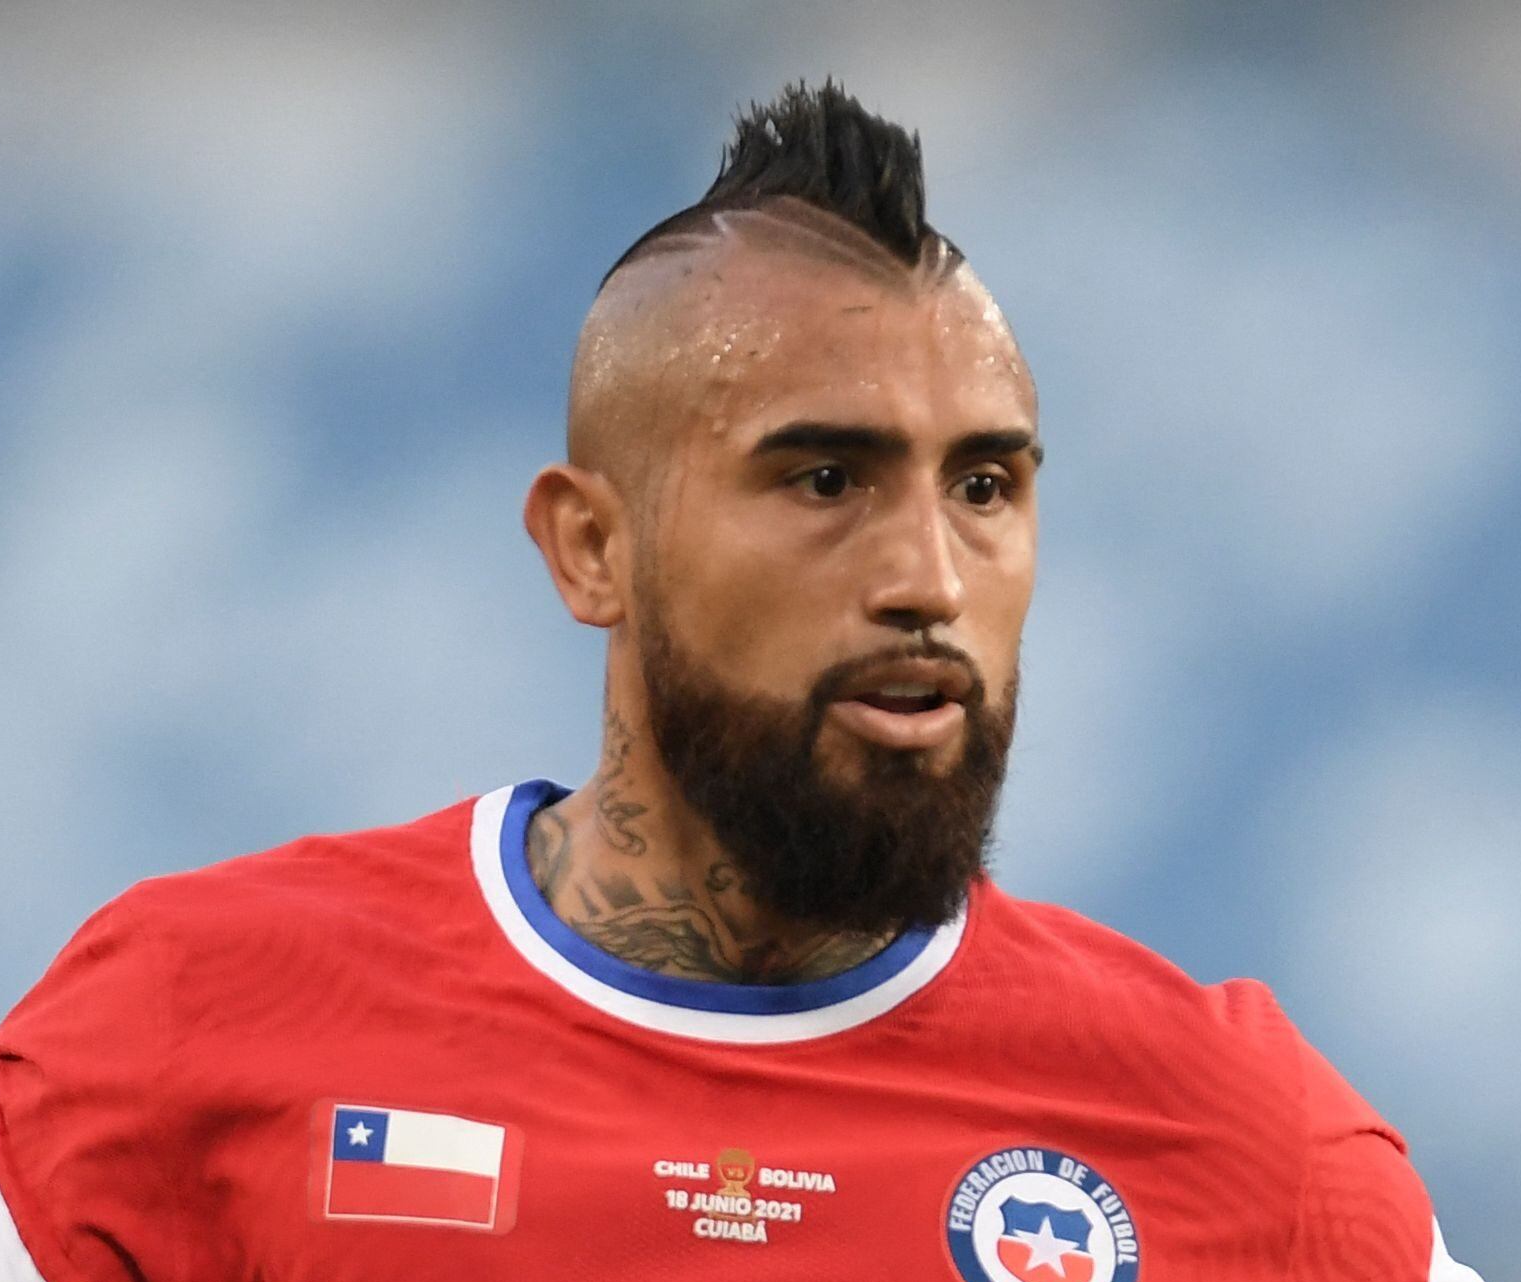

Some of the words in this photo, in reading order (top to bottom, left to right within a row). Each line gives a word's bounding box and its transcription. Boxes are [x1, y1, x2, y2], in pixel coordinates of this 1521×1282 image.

[654, 1160, 711, 1180] CHILE
[758, 1167, 836, 1193] BOLIVIA
[665, 1189, 689, 1209] 18
[689, 1193, 752, 1216] JUNIO
[754, 1200, 802, 1222] 2021
[948, 1149, 1045, 1232] FEDERACION
[1058, 1157, 1089, 1186] DE
[1090, 1182, 1138, 1265] FUTBOL
[693, 1217, 768, 1244] CUIABÁ
